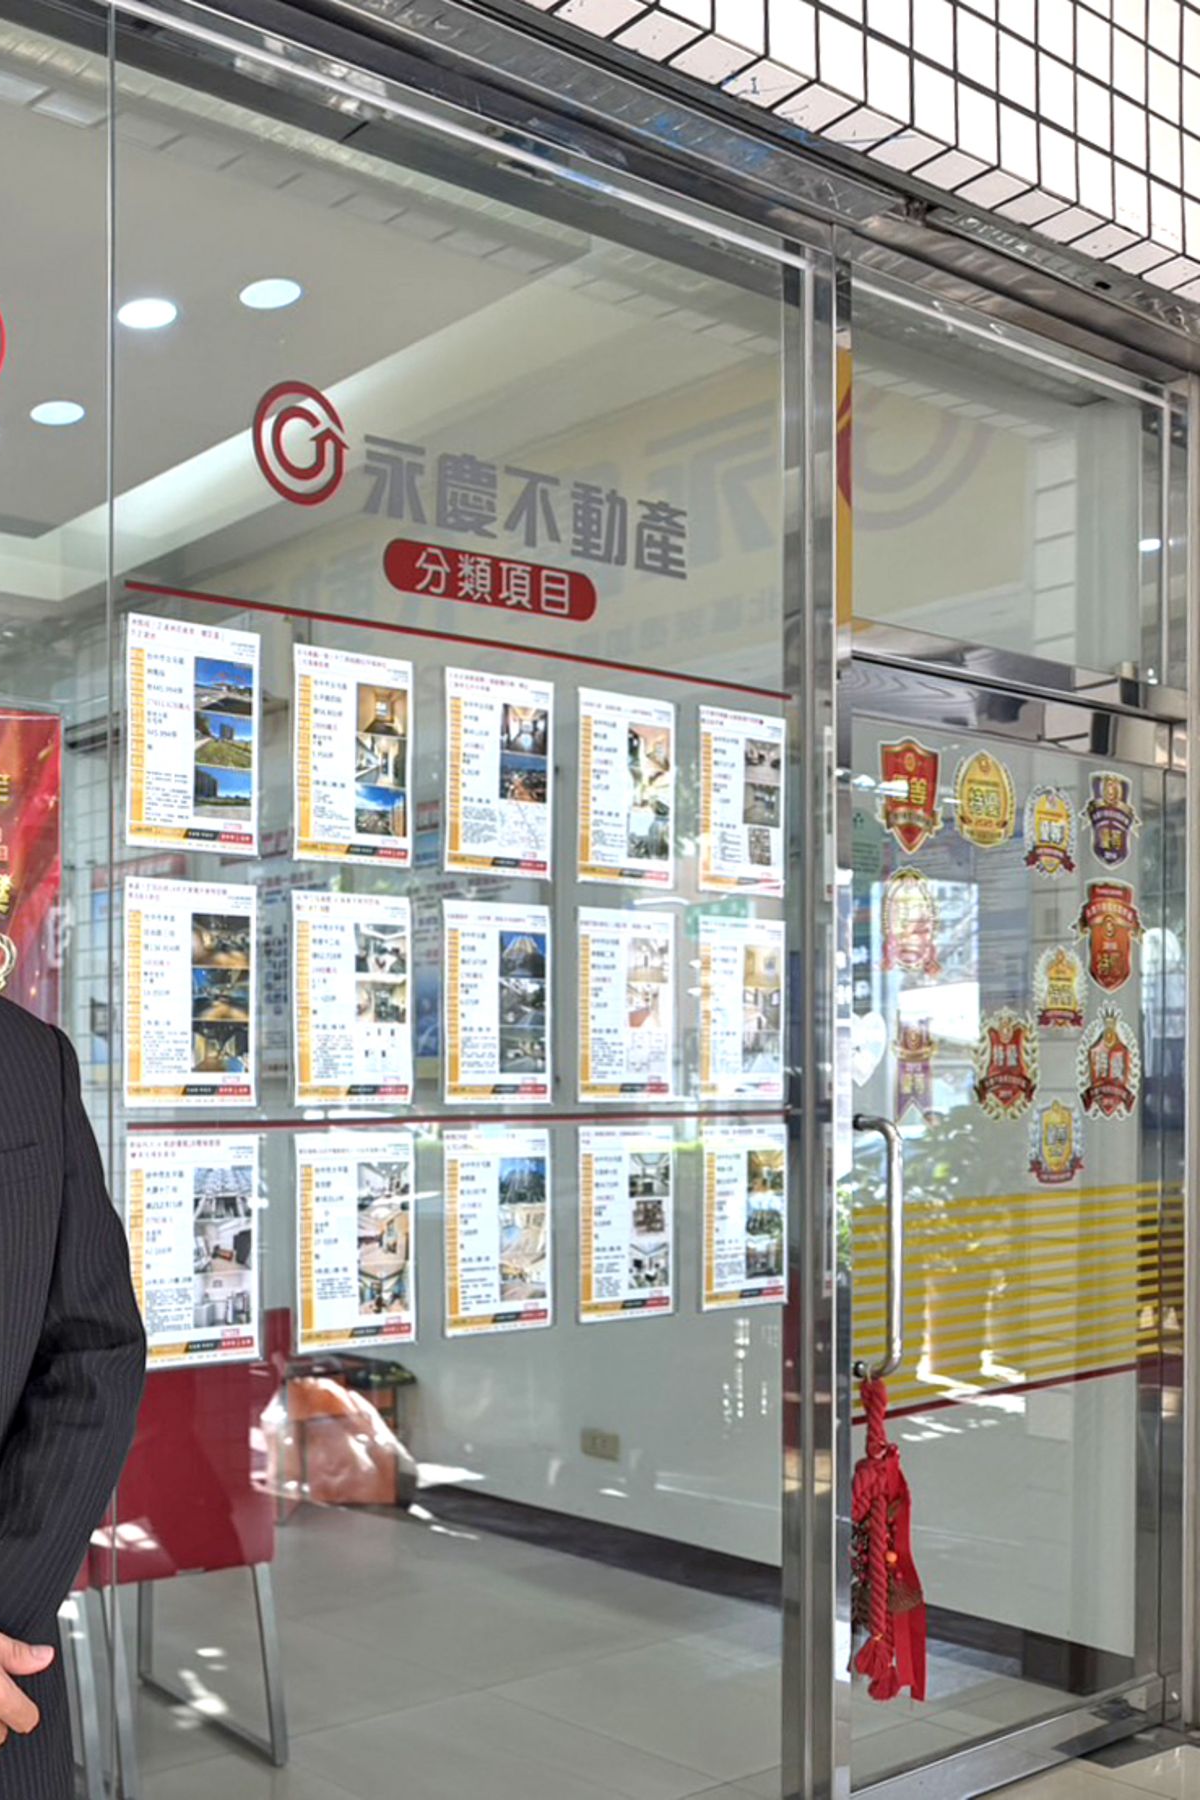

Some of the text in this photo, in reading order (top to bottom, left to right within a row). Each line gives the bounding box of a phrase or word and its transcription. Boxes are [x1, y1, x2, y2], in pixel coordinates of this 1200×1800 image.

[362, 434, 688, 581] 永慶不動產
[414, 546, 570, 616] 分類項目
